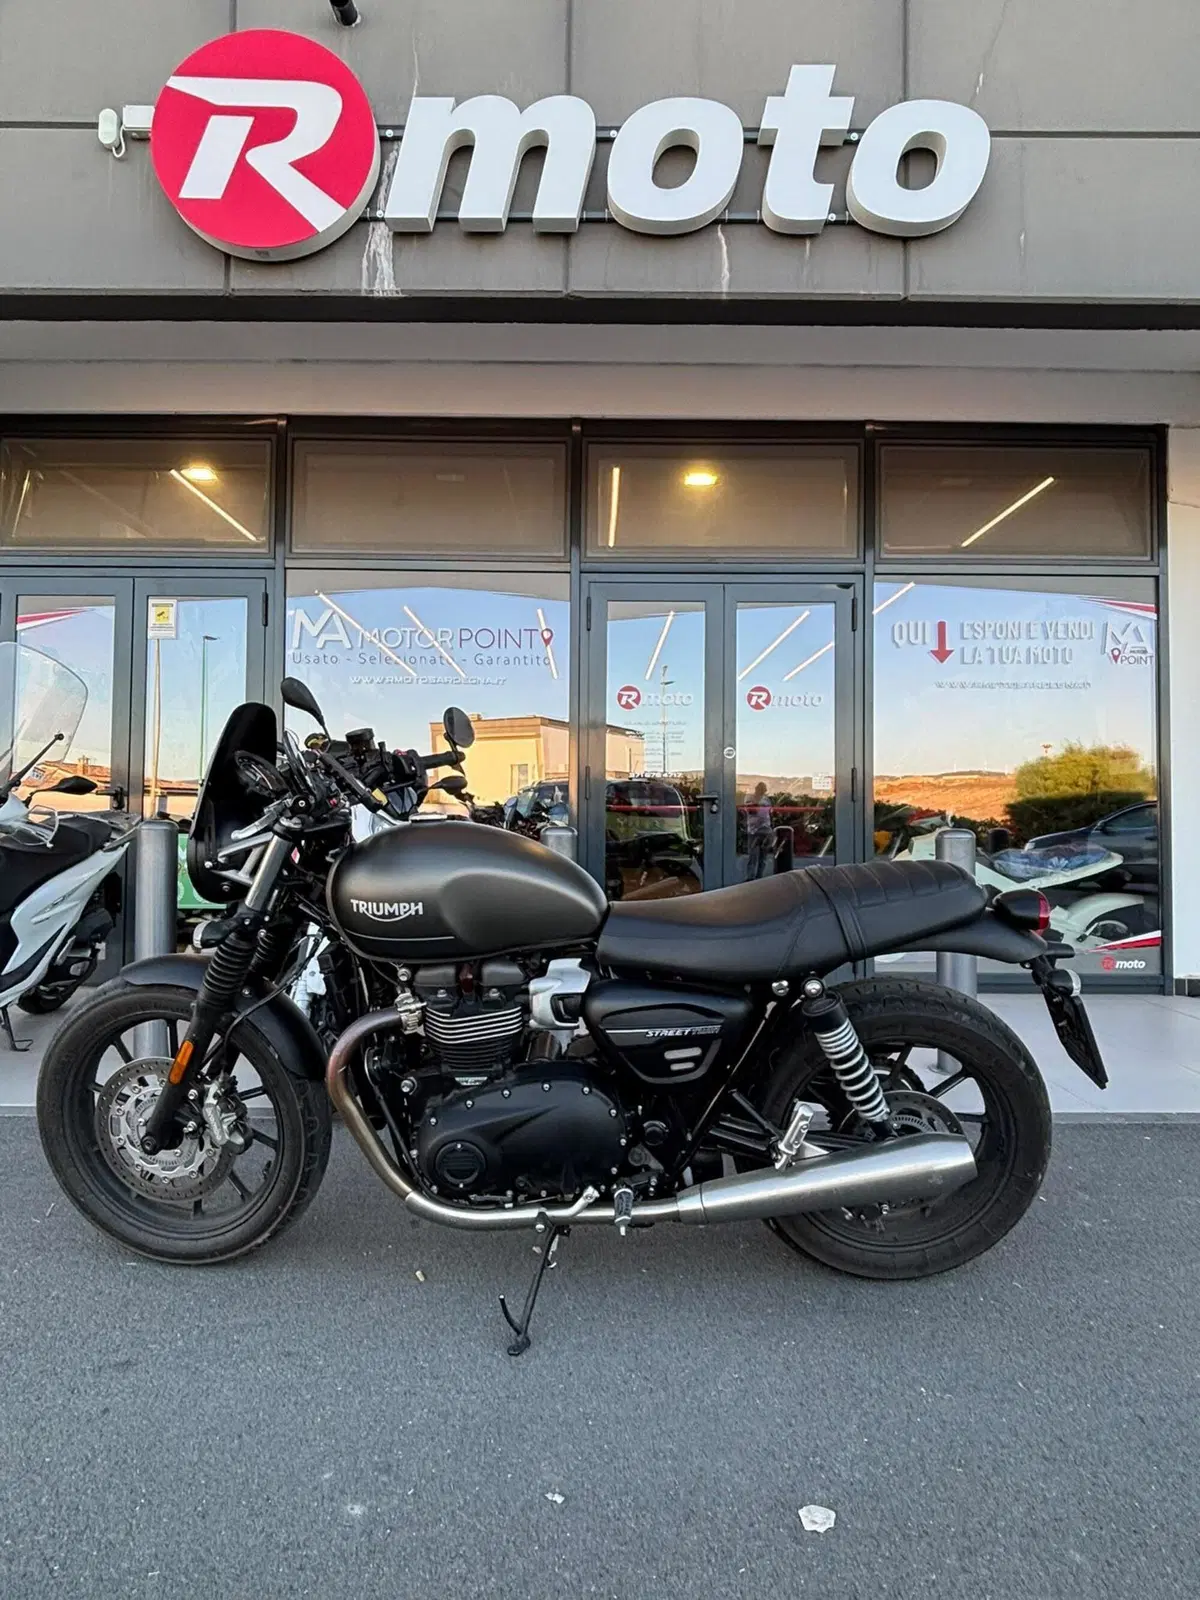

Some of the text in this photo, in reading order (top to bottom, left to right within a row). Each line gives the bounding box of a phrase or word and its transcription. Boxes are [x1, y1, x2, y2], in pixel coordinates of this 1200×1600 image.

[165, 64, 991, 236] R moto
[892, 620, 929, 648] QUI
[1043, 620, 1094, 640] VENDI
[292, 653, 339, 665] Usato
[474, 653, 551, 666] Garantito
[959, 645, 1074, 665] LA TUA MOTO
[1120, 655, 1154, 665] POINT
[642, 692, 693, 707] moto
[350, 898, 424, 923] TRIUMPH
[1115, 959, 1146, 969] moto
[645, 1029, 691, 1037] STREET
